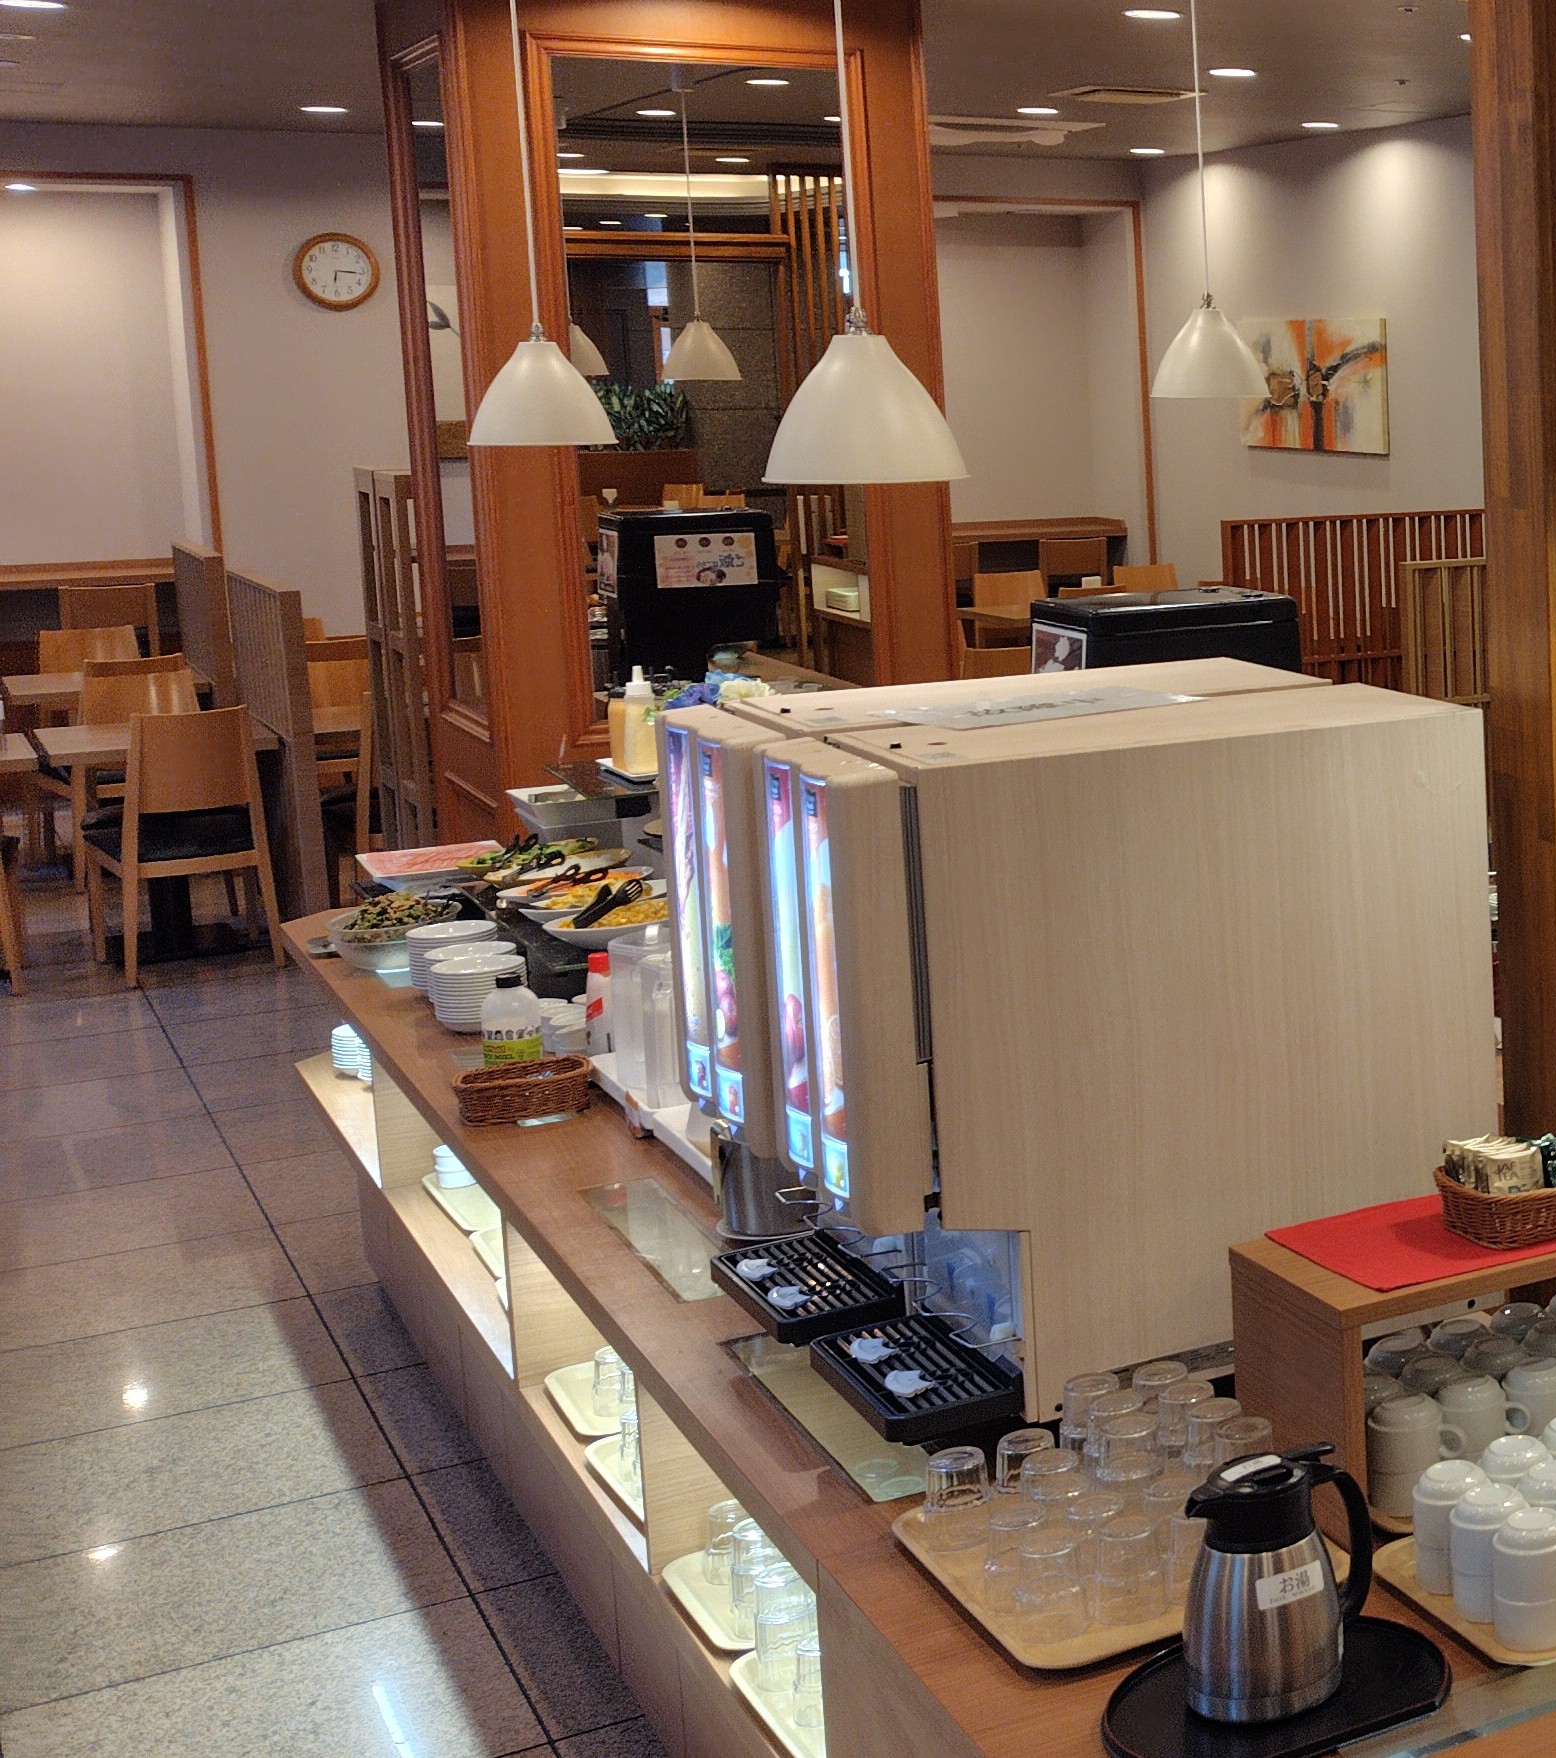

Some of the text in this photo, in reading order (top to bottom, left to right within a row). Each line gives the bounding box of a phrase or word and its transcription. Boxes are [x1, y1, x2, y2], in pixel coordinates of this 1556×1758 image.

[318, 246, 326, 255] 11
[331, 243, 340, 252] 12
[346, 246, 350, 255] 1
[309, 254, 317, 263] 10
[354, 255, 361, 264] 2
[306, 265, 313, 274] 9
[359, 266, 365, 276] 3
[310, 277, 317, 286] 8
[355, 278, 362, 287] 4
[321, 285, 327, 294] 7
[334, 289, 341, 298] 6
[347, 285, 353, 295] 5
[1279, 1569, 1311, 1594] お湯
